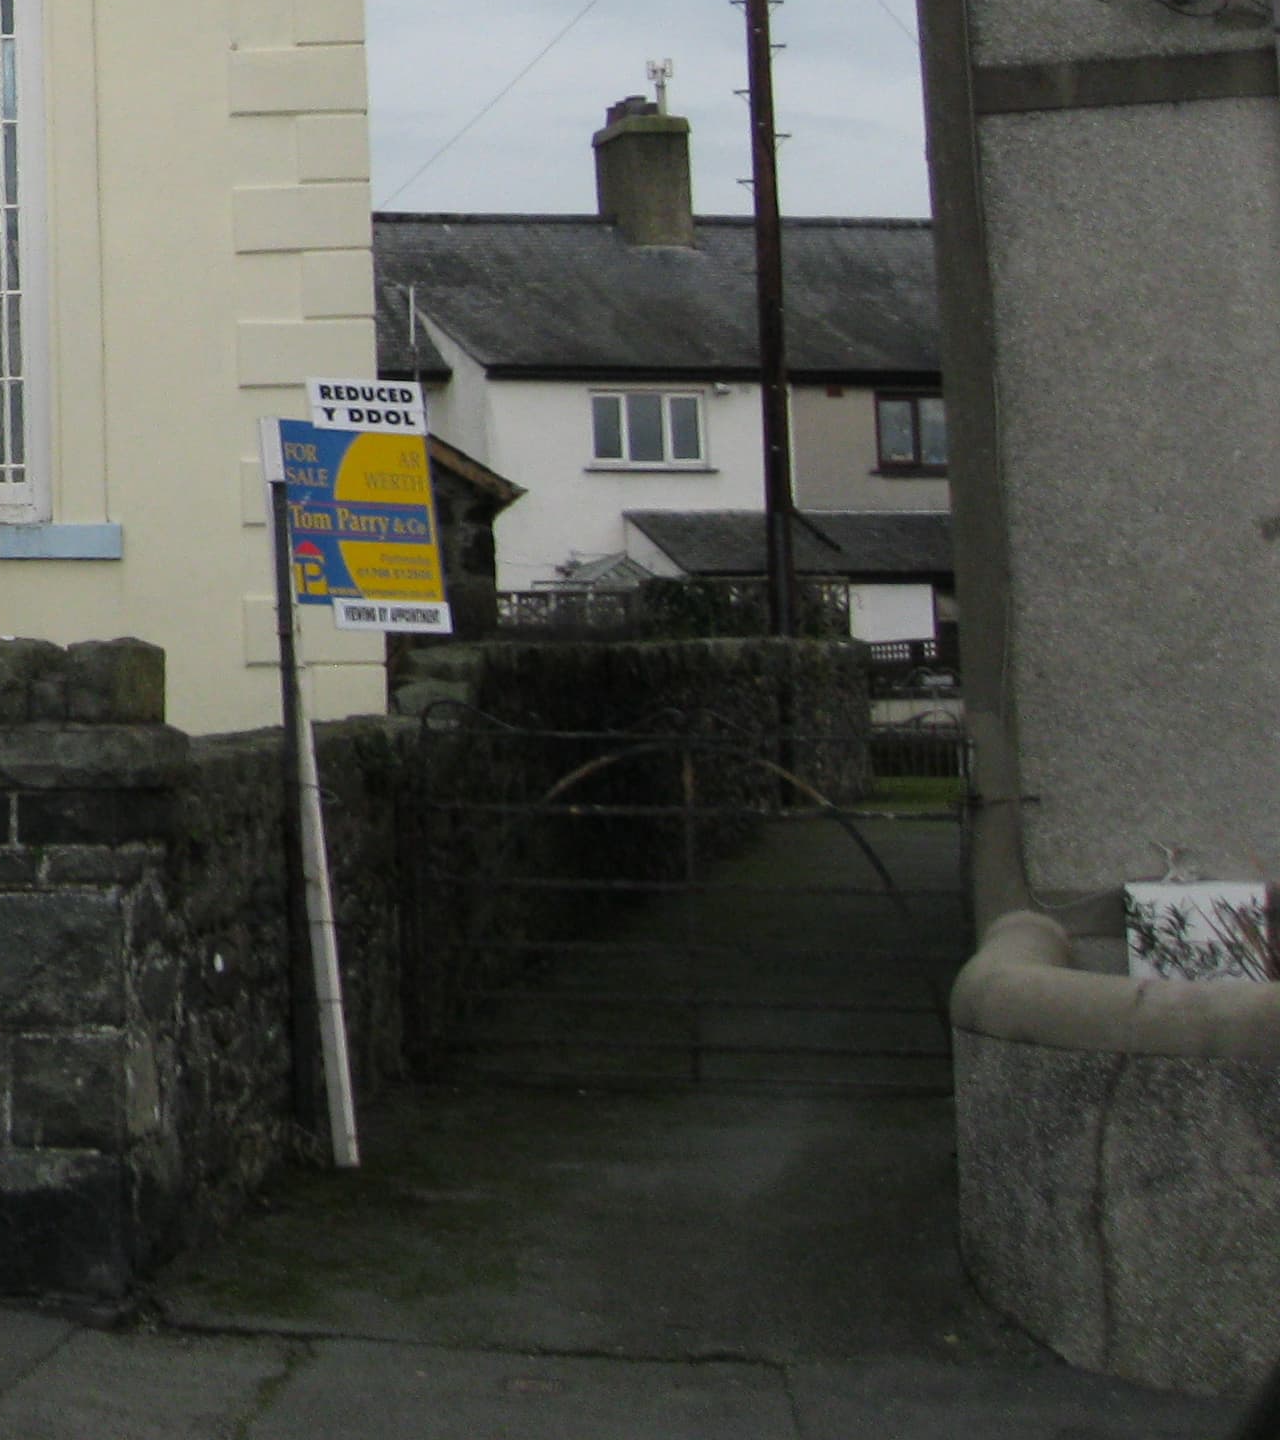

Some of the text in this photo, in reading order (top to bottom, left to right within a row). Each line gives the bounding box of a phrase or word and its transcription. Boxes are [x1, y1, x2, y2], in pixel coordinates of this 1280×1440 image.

[319, 384, 413, 404] REDUCED
[323, 407, 415, 426] Y DDOL
[284, 442, 318, 462] FOR
[285, 466, 328, 488] SALE
[364, 471, 424, 492] WERTH
[288, 504, 332, 531] Tom
[336, 506, 389, 539] Parry
